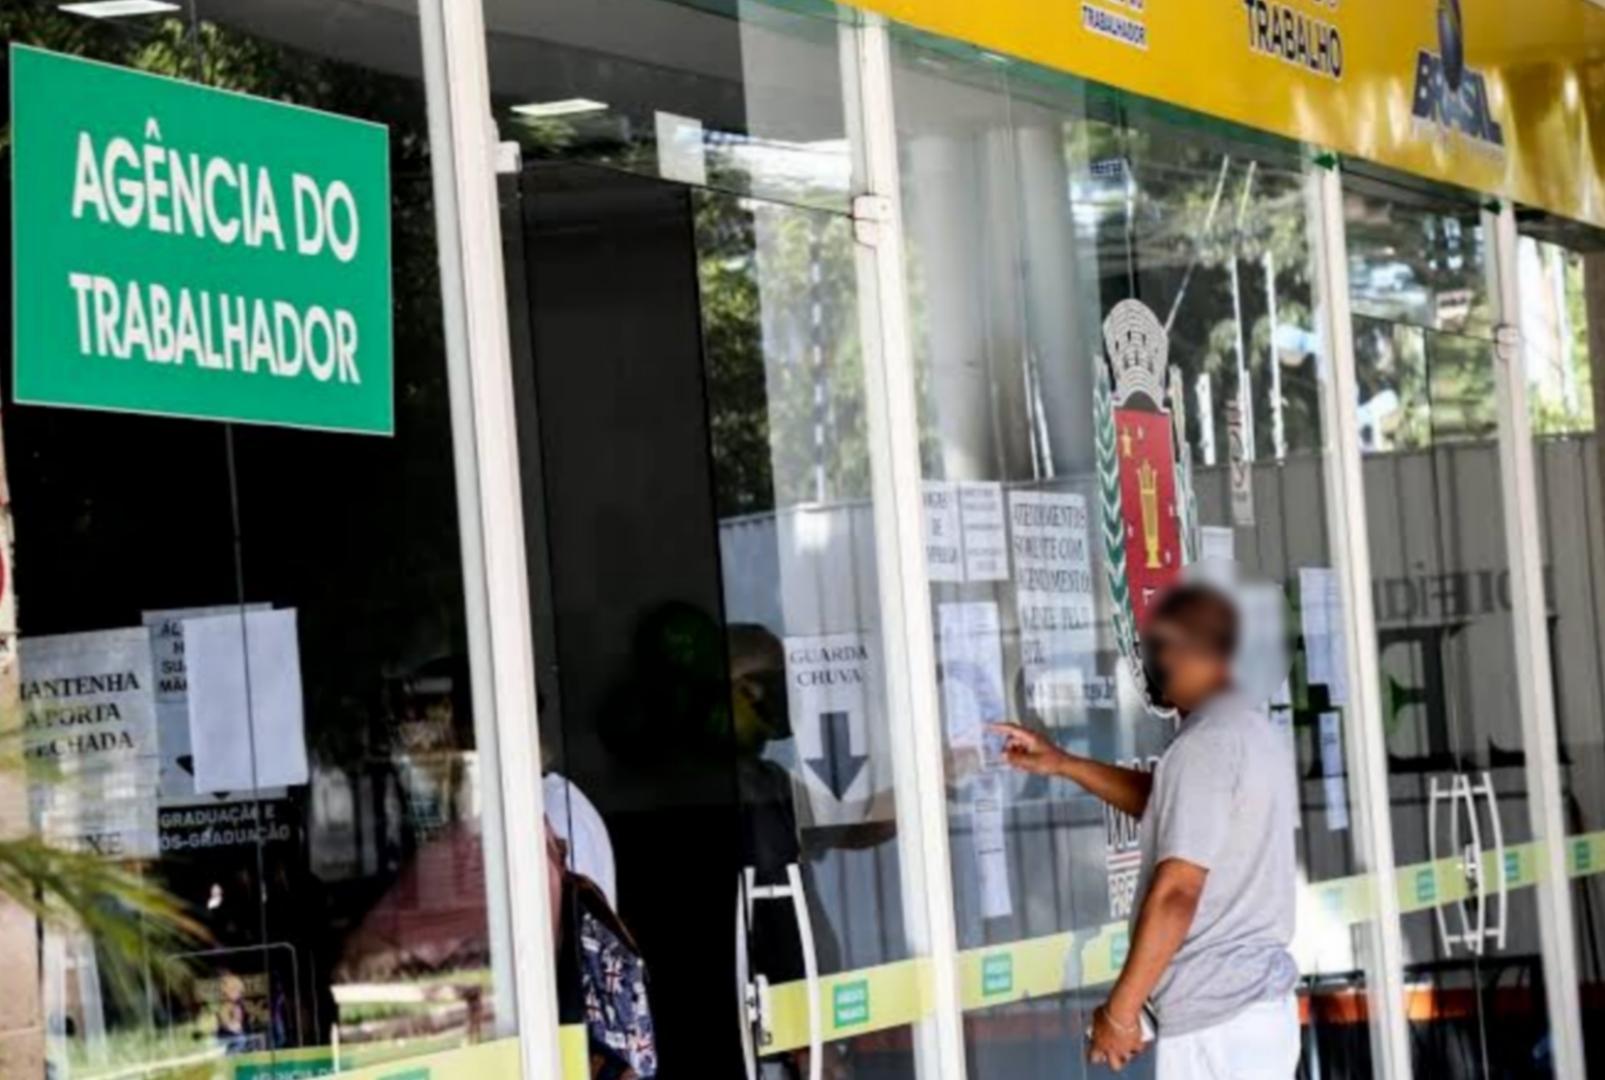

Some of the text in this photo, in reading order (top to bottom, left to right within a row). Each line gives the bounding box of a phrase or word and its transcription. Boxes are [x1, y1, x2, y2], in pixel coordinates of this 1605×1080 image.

[1245, 0, 1343, 78] TRABALHO
[72, 117, 360, 262] AGÊNCIA DO
[69, 272, 361, 385] TRABALHADOR
[790, 644, 869, 664] GUARDA
[797, 667, 862, 688] CHUVA
[159, 822, 291, 851] ÓS-GRADUAÇÃO
